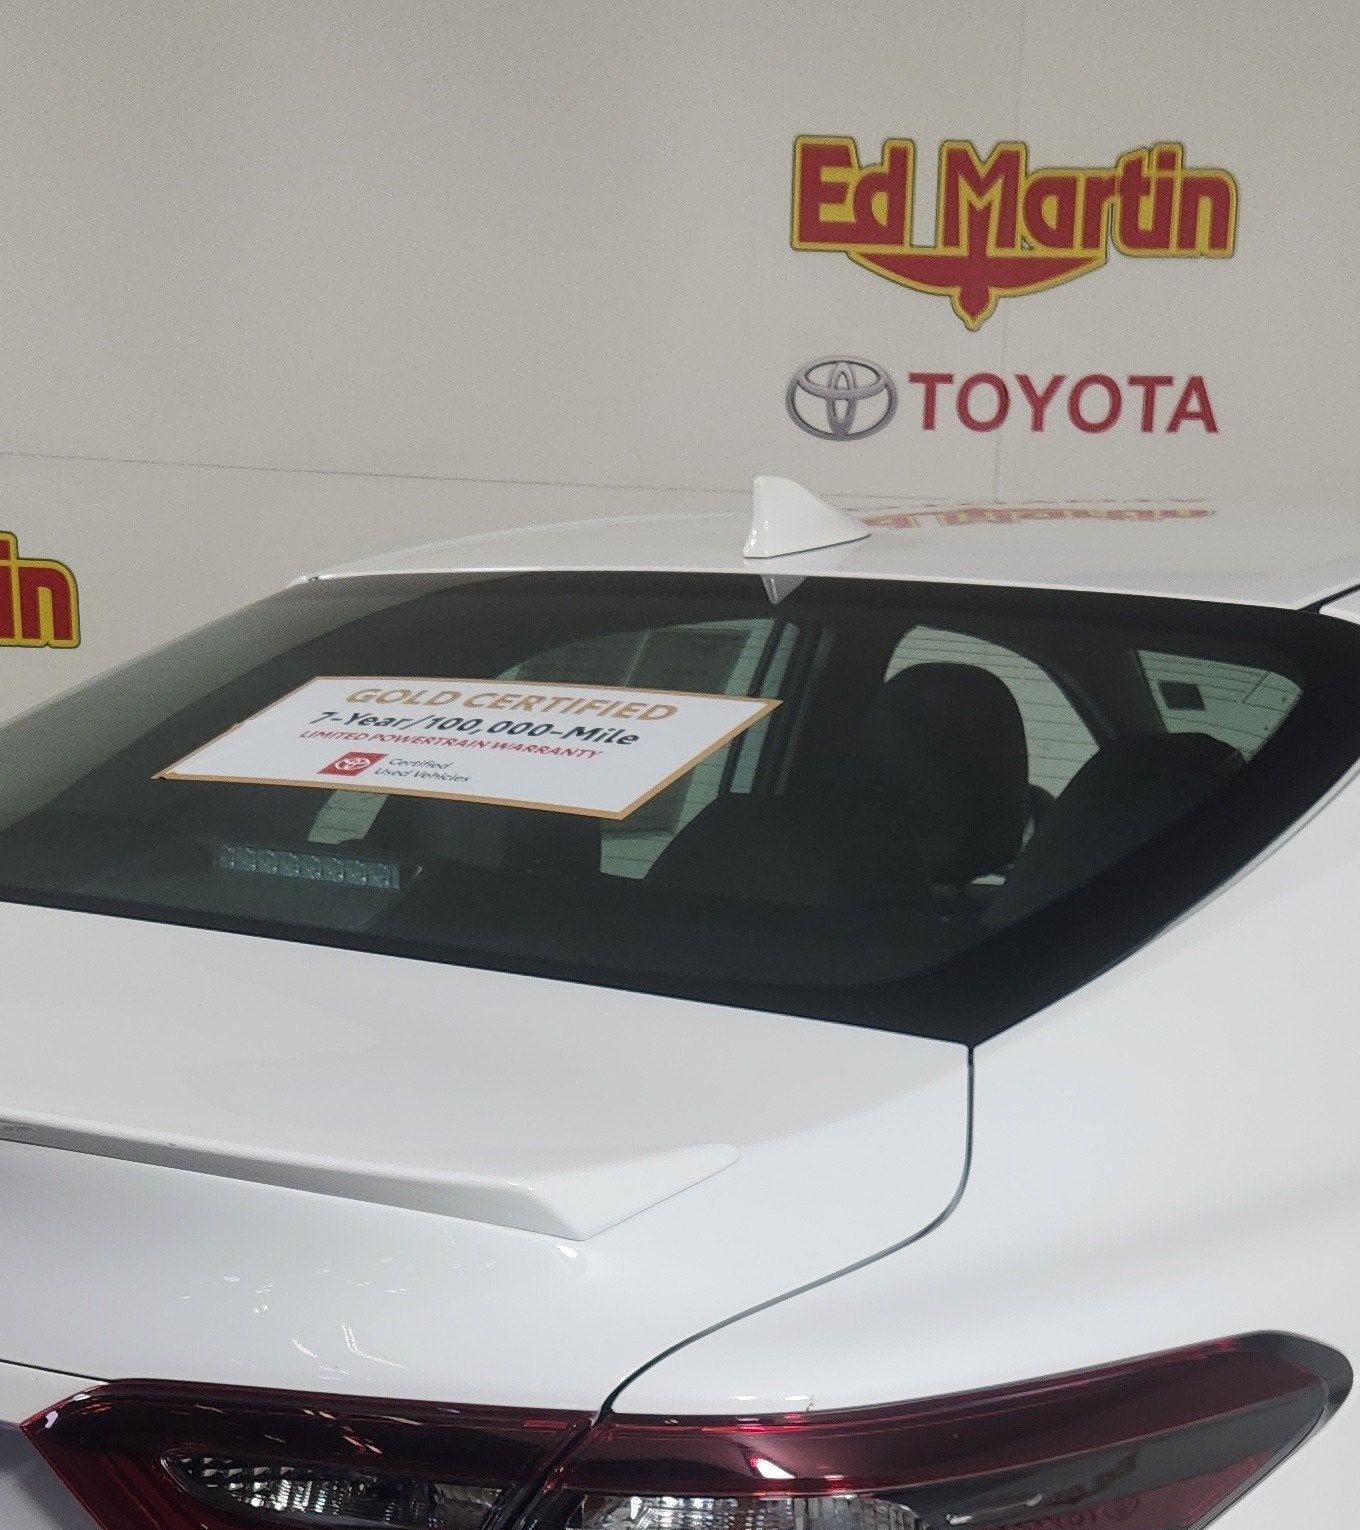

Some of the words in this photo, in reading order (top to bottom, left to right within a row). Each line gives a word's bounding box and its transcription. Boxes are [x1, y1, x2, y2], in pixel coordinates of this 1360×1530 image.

[791, 134, 915, 252] Ed
[940, 141, 1238, 258] Martin
[908, 371, 1220, 433] TOYOTA
[346, 688, 461, 708] GOLD
[463, 691, 679, 722] CERTIFIED
[298, 730, 373, 742] LIMITED
[369, 732, 491, 751] POWERTRAIN
[487, 740, 604, 760] WARRANTY
[309, 711, 641, 747] 7-Year/100,000-Mile
[373, 767, 422, 780] Used
[420, 768, 472, 784] Vehicles
[388, 756, 452, 770] Certified
